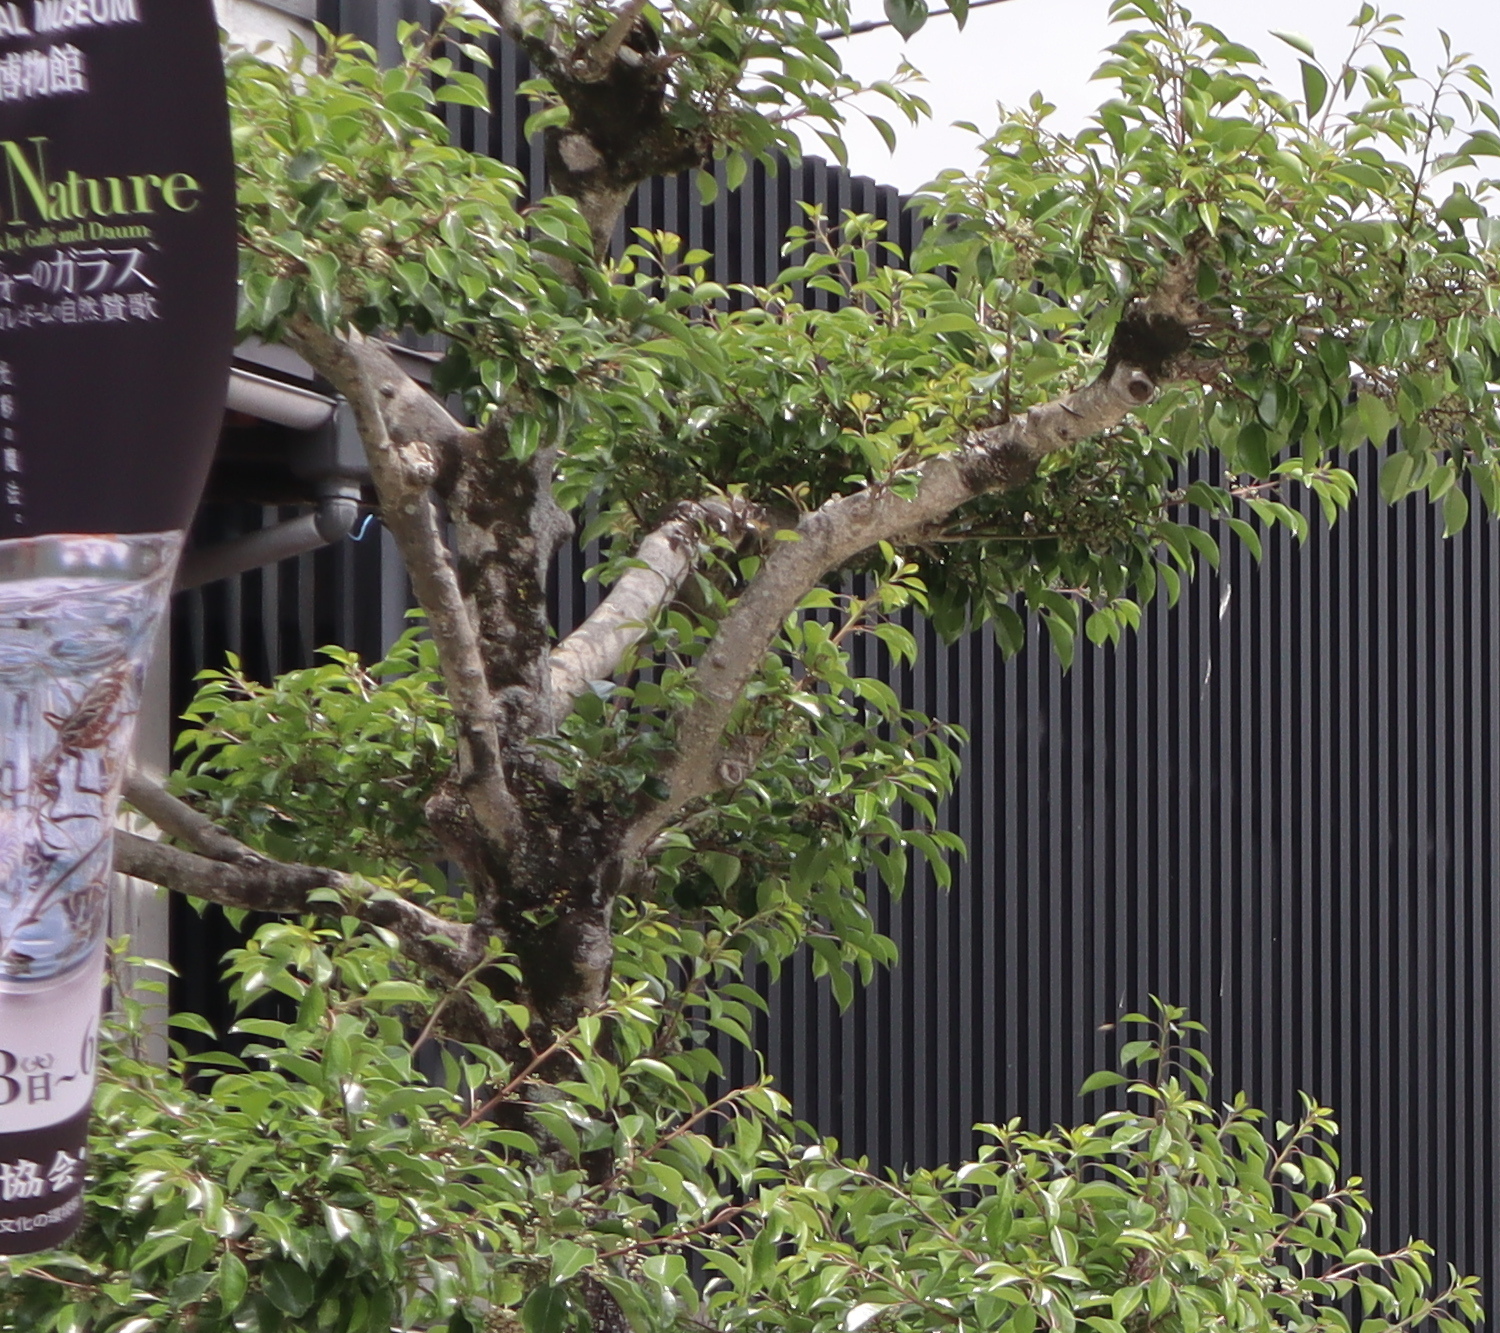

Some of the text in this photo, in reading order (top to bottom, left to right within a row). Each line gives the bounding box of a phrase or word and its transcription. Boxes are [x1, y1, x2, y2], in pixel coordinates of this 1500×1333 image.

[0, 136, 202, 223] Nature
[58, 222, 84, 243] and
[89, 221, 151, 241] Daum
